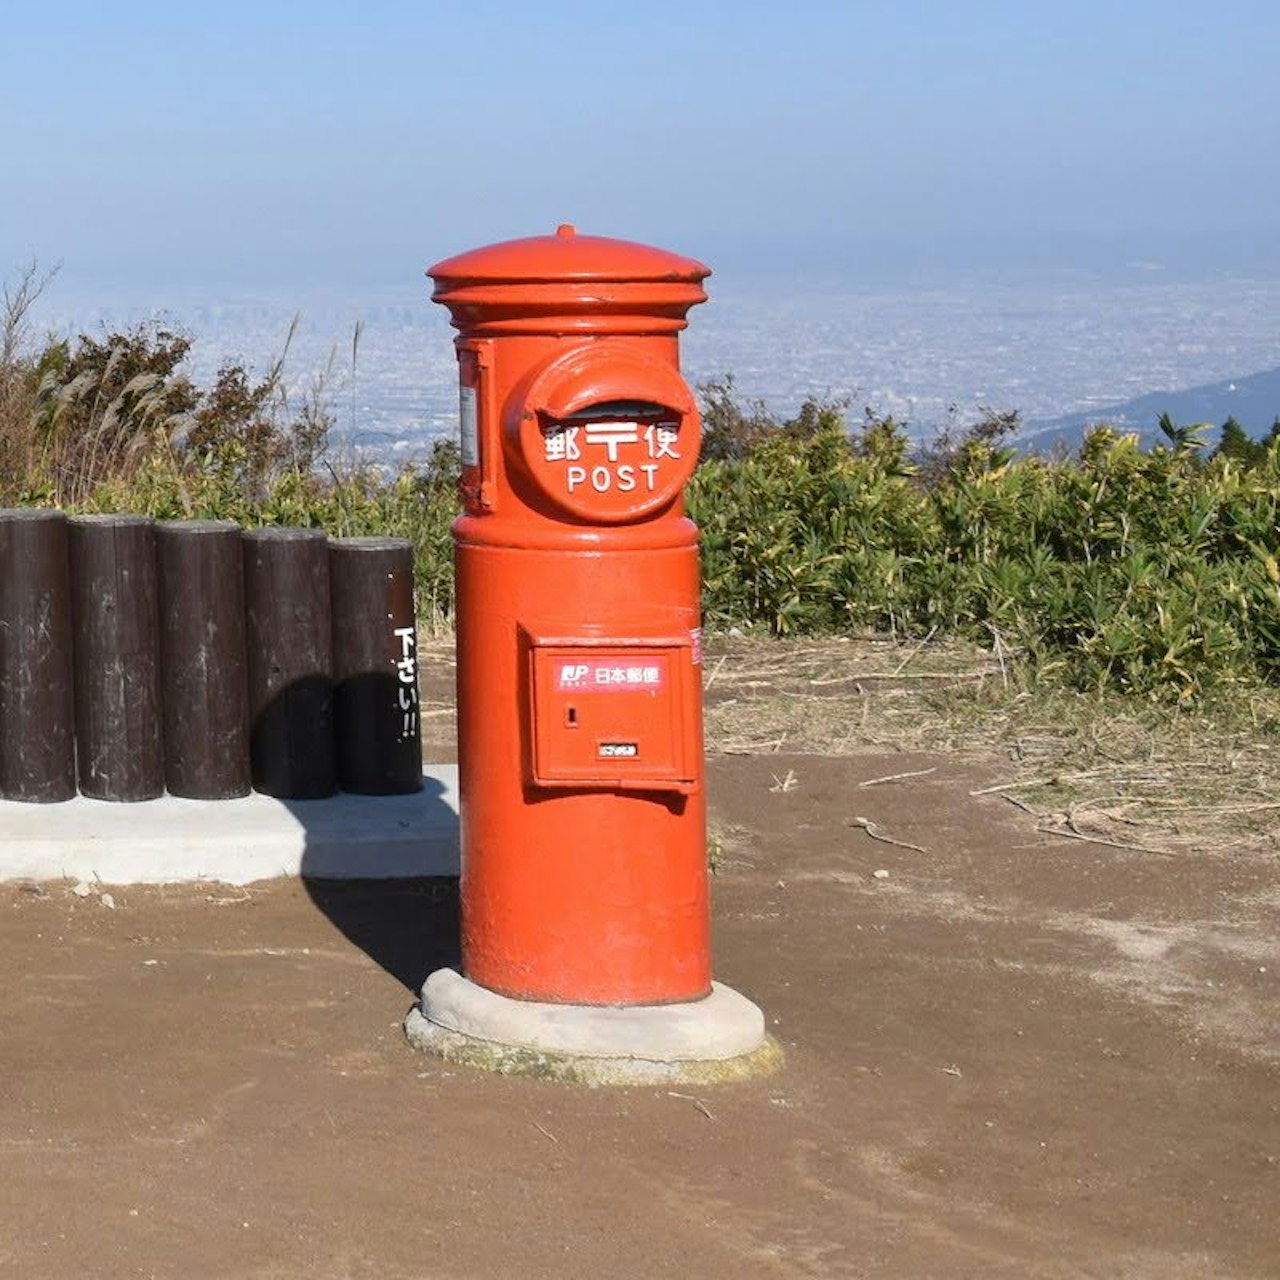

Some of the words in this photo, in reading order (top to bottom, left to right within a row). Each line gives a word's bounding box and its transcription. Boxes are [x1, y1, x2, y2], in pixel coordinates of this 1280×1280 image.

[567, 464, 659, 494] POST
[595, 667, 661, 684] 日本郵便
